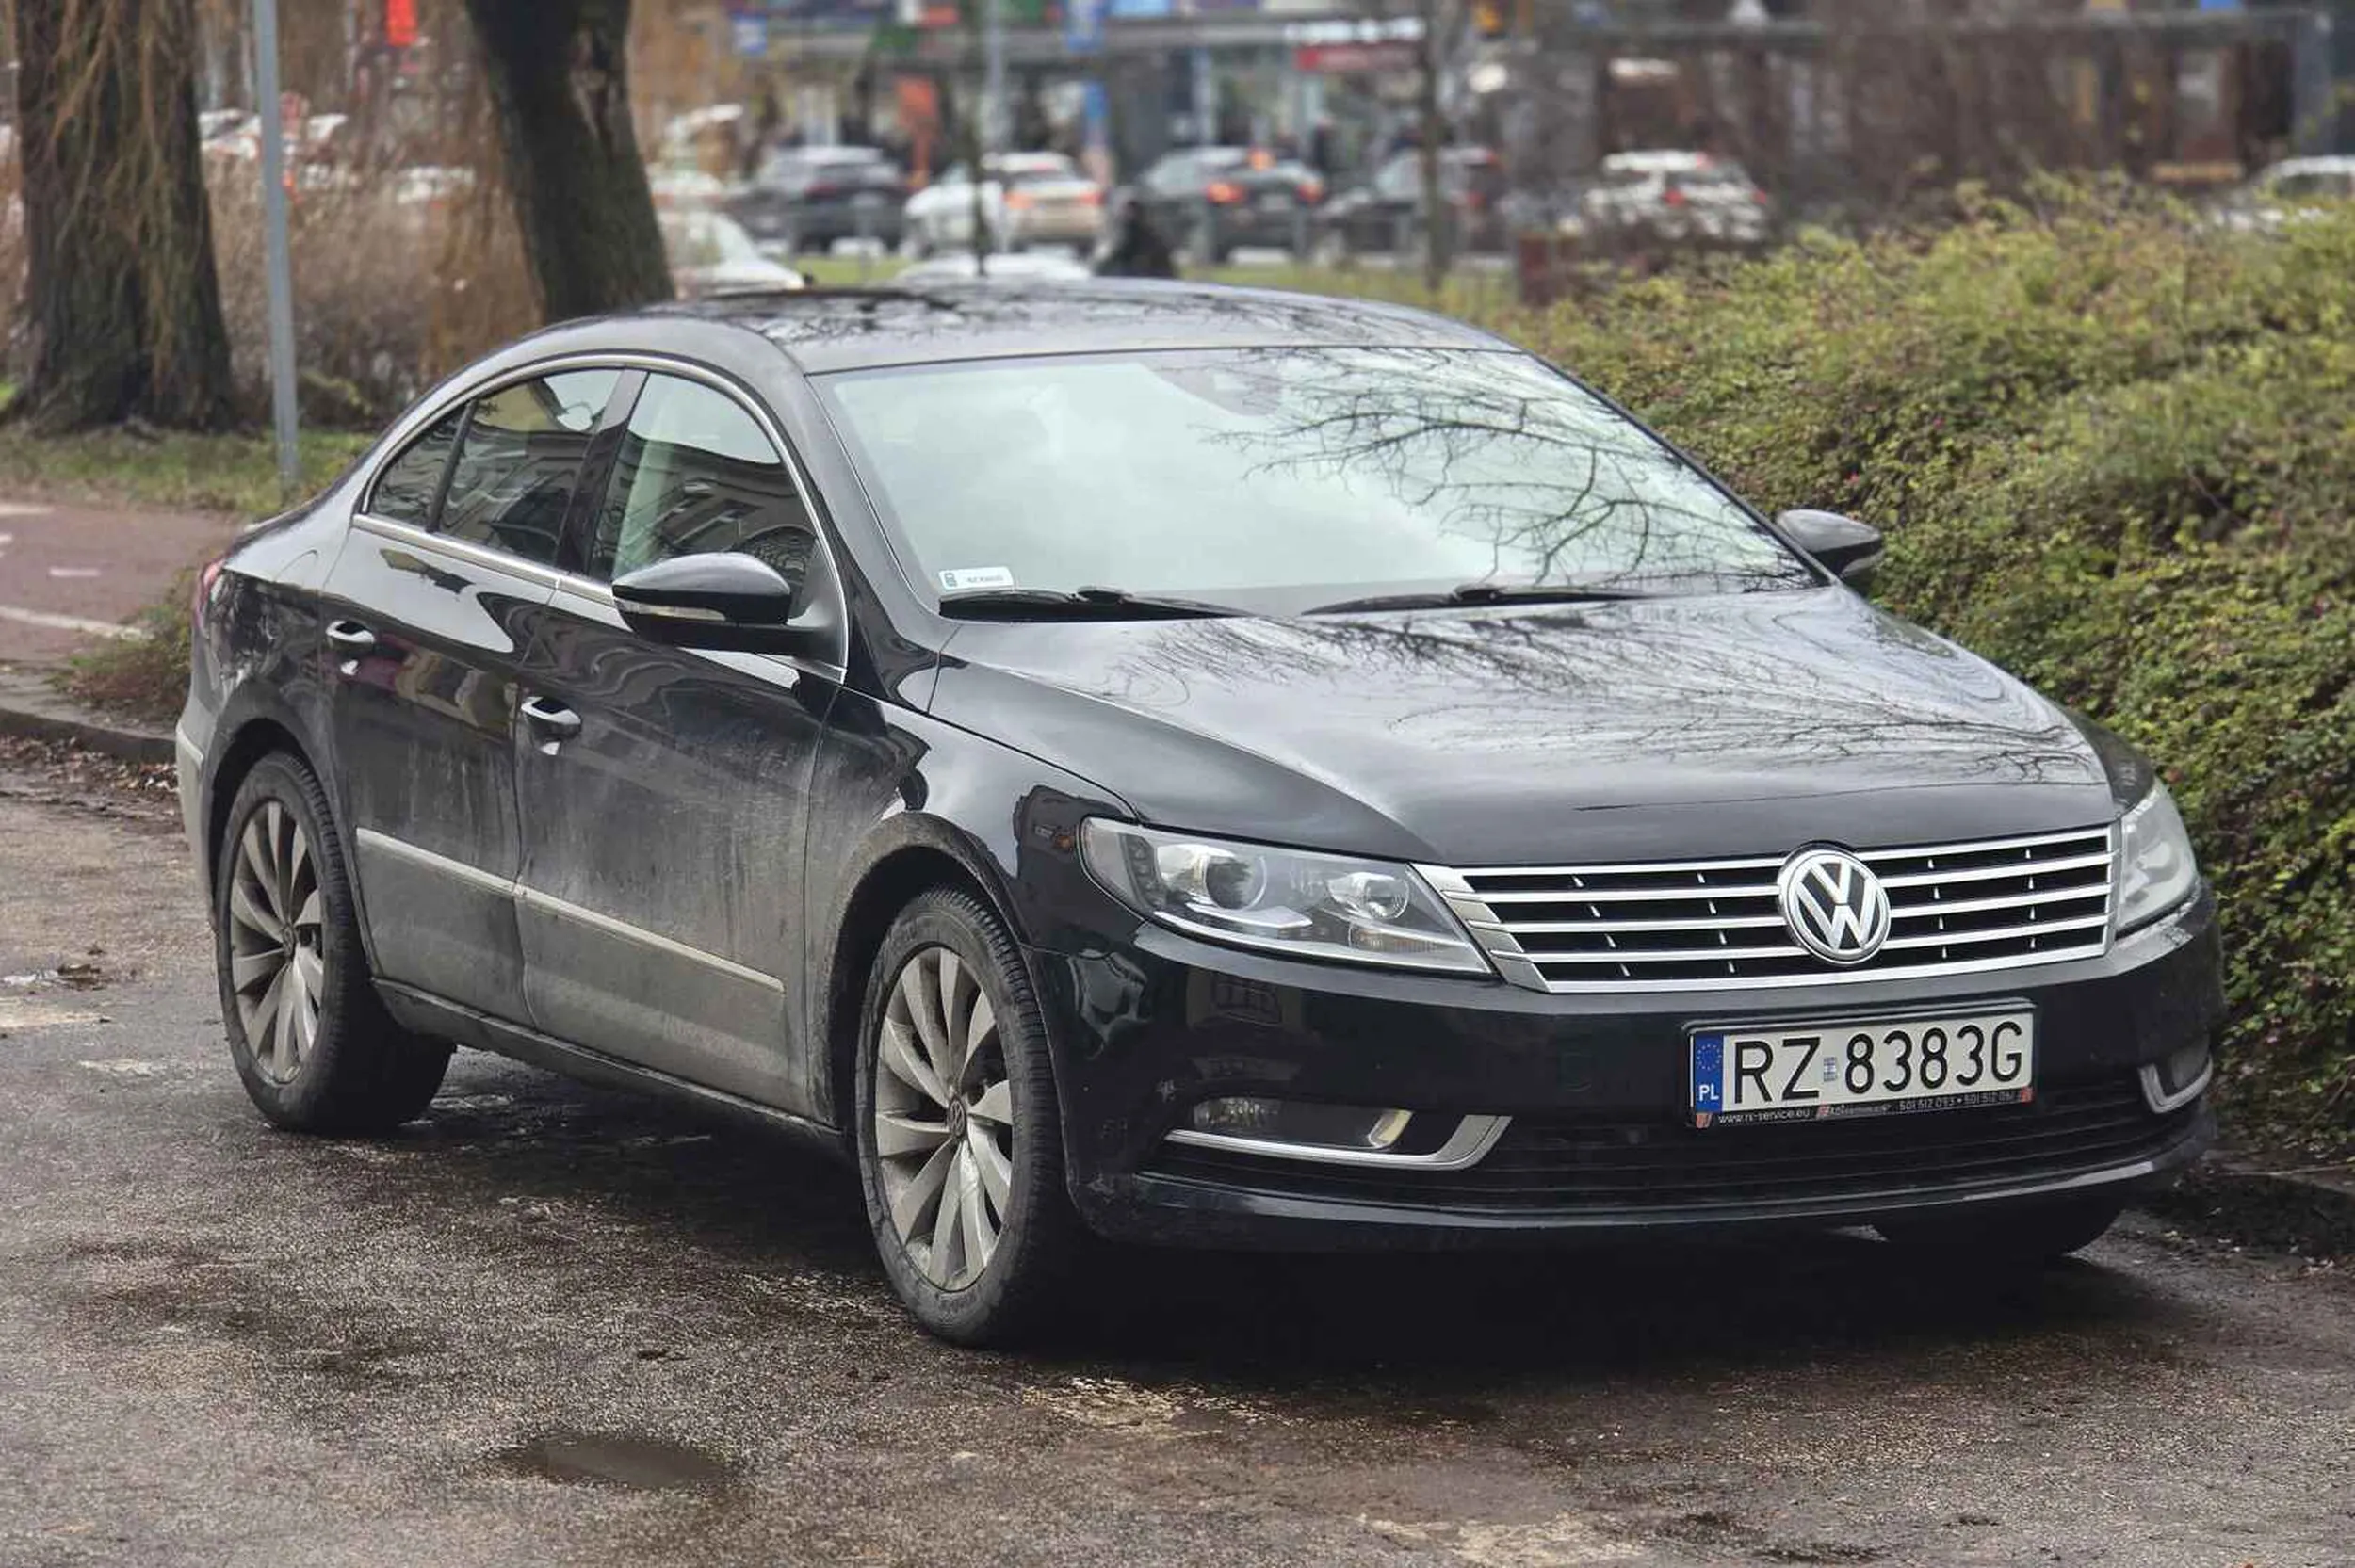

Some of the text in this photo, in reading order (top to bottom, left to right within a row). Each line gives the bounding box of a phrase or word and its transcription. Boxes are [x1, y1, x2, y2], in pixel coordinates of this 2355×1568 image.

[1734, 1021, 2022, 1104] RZ 8383G
[1698, 1084, 1720, 1103] PL
